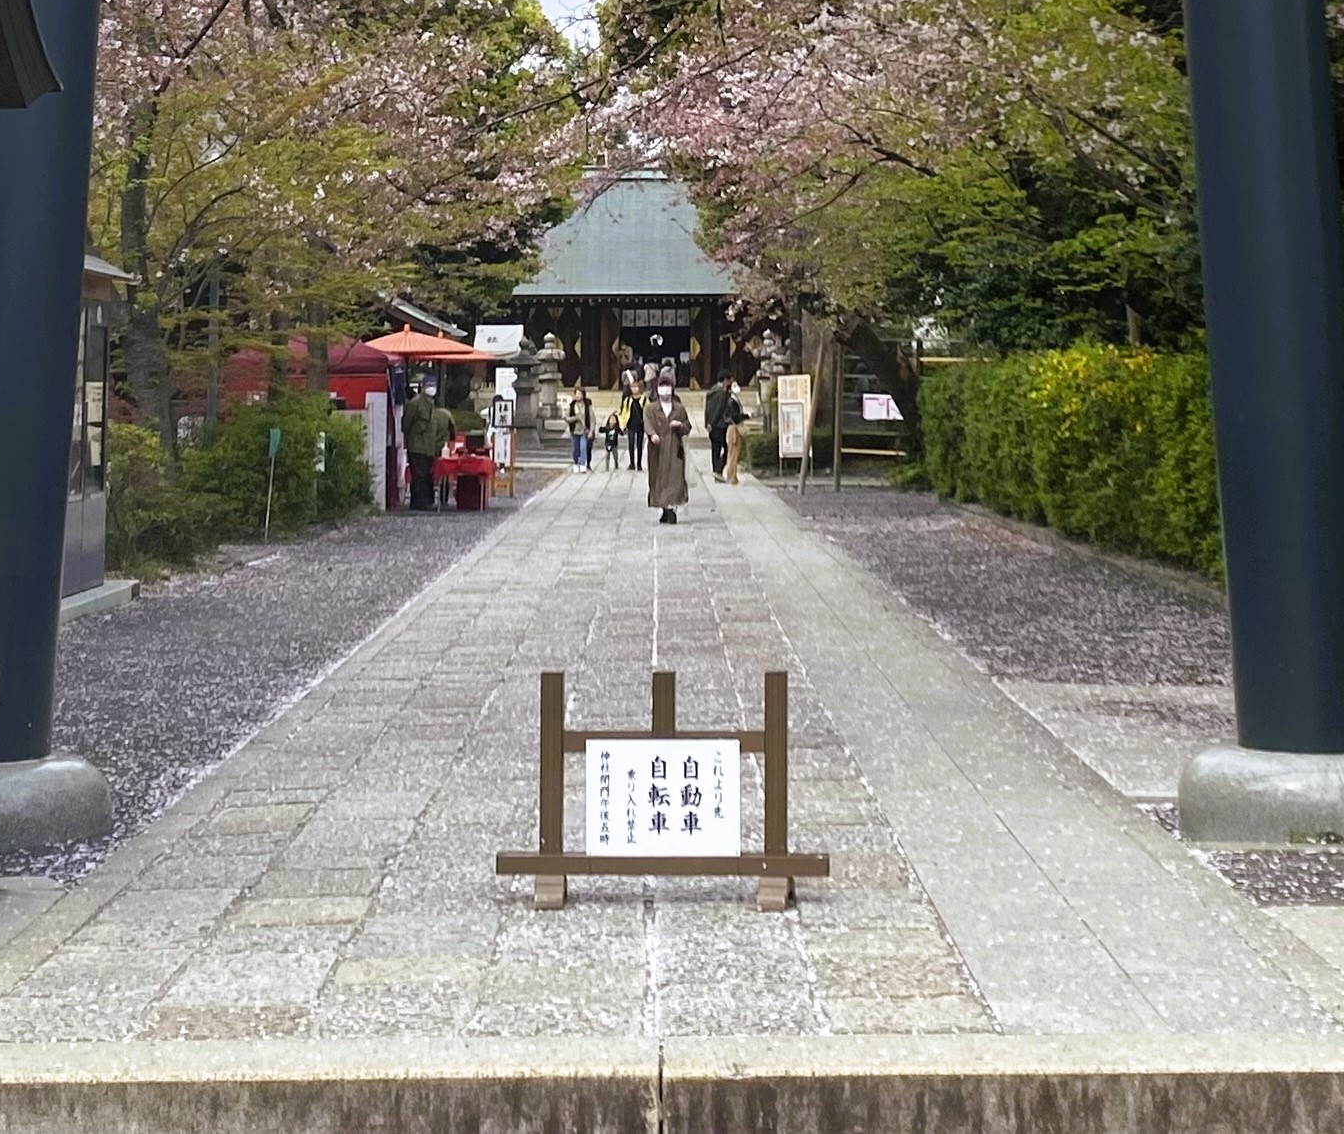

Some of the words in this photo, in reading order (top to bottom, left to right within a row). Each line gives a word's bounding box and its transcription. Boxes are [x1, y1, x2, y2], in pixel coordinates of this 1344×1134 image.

[648, 755, 671, 835] 自転車
[680, 755, 702, 835] 自動車
